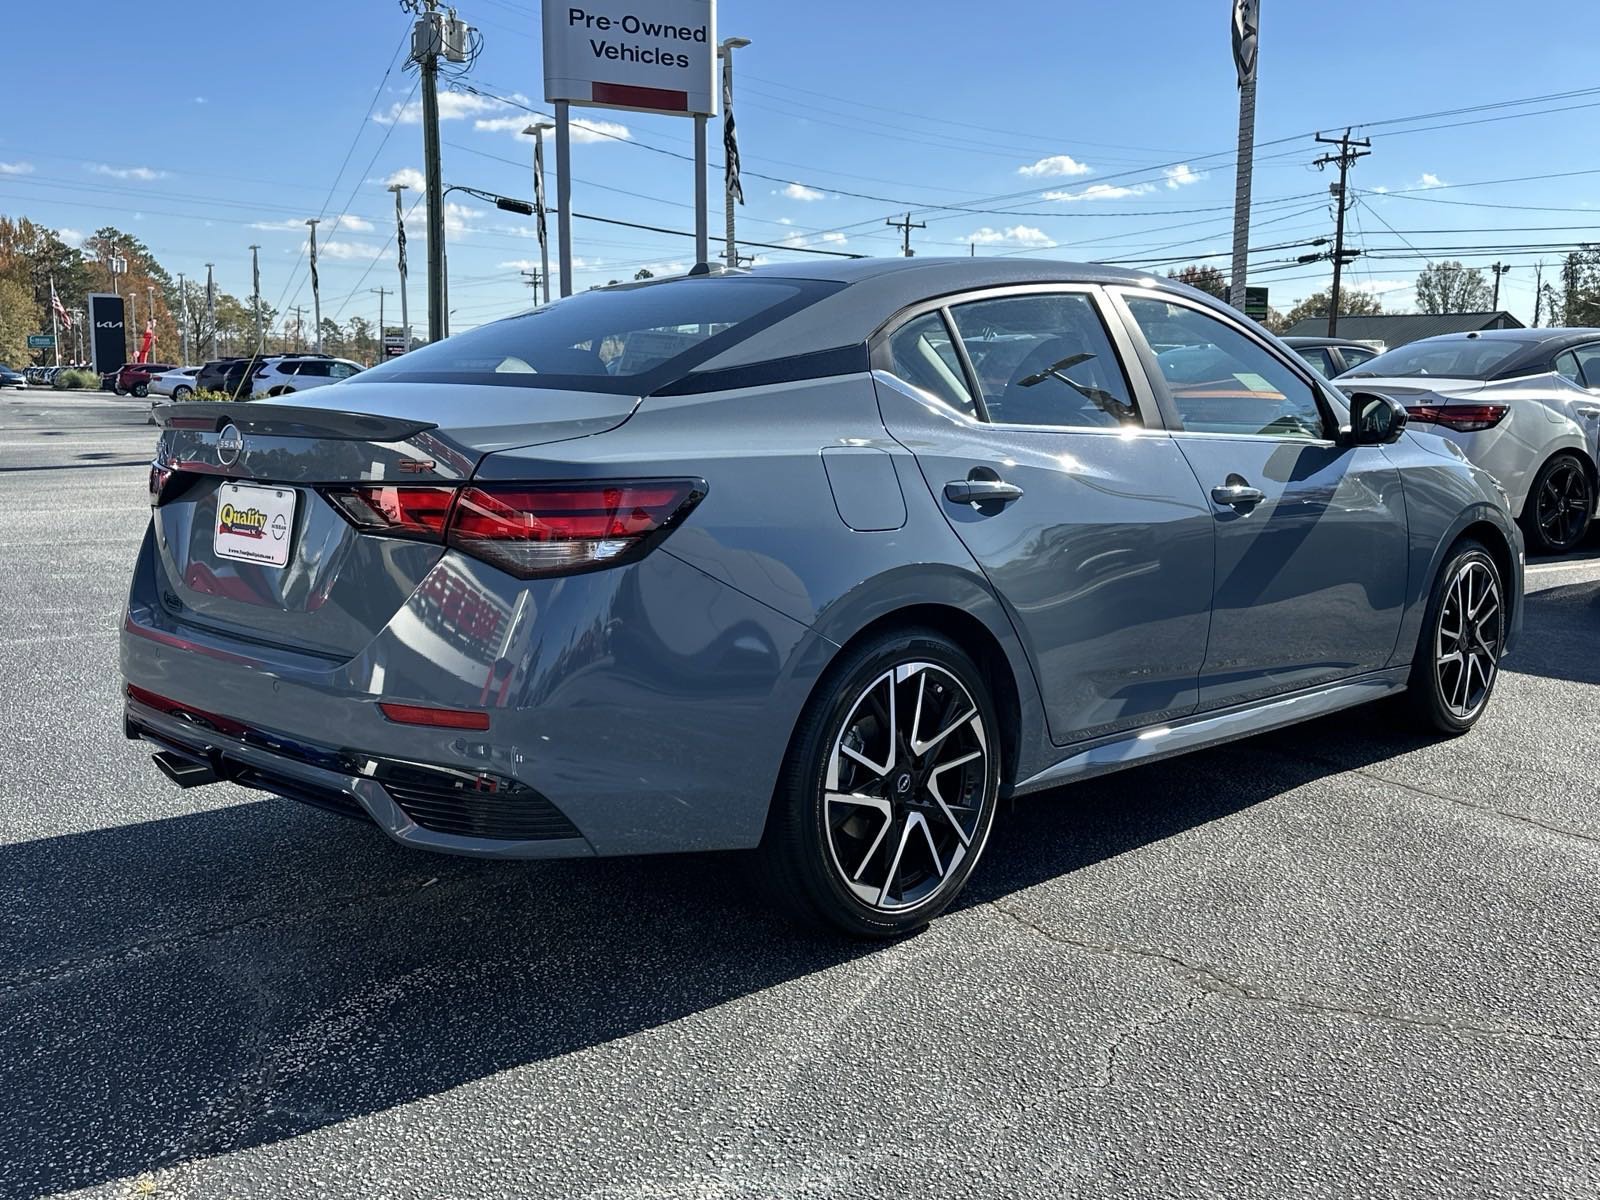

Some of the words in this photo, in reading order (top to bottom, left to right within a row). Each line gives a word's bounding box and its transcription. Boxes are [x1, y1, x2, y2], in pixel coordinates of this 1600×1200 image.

[569, 8, 707, 43] Pre-Owned
[589, 38, 690, 68] Vehicles
[399, 458, 434, 473] SR
[221, 504, 267, 529] Quality
